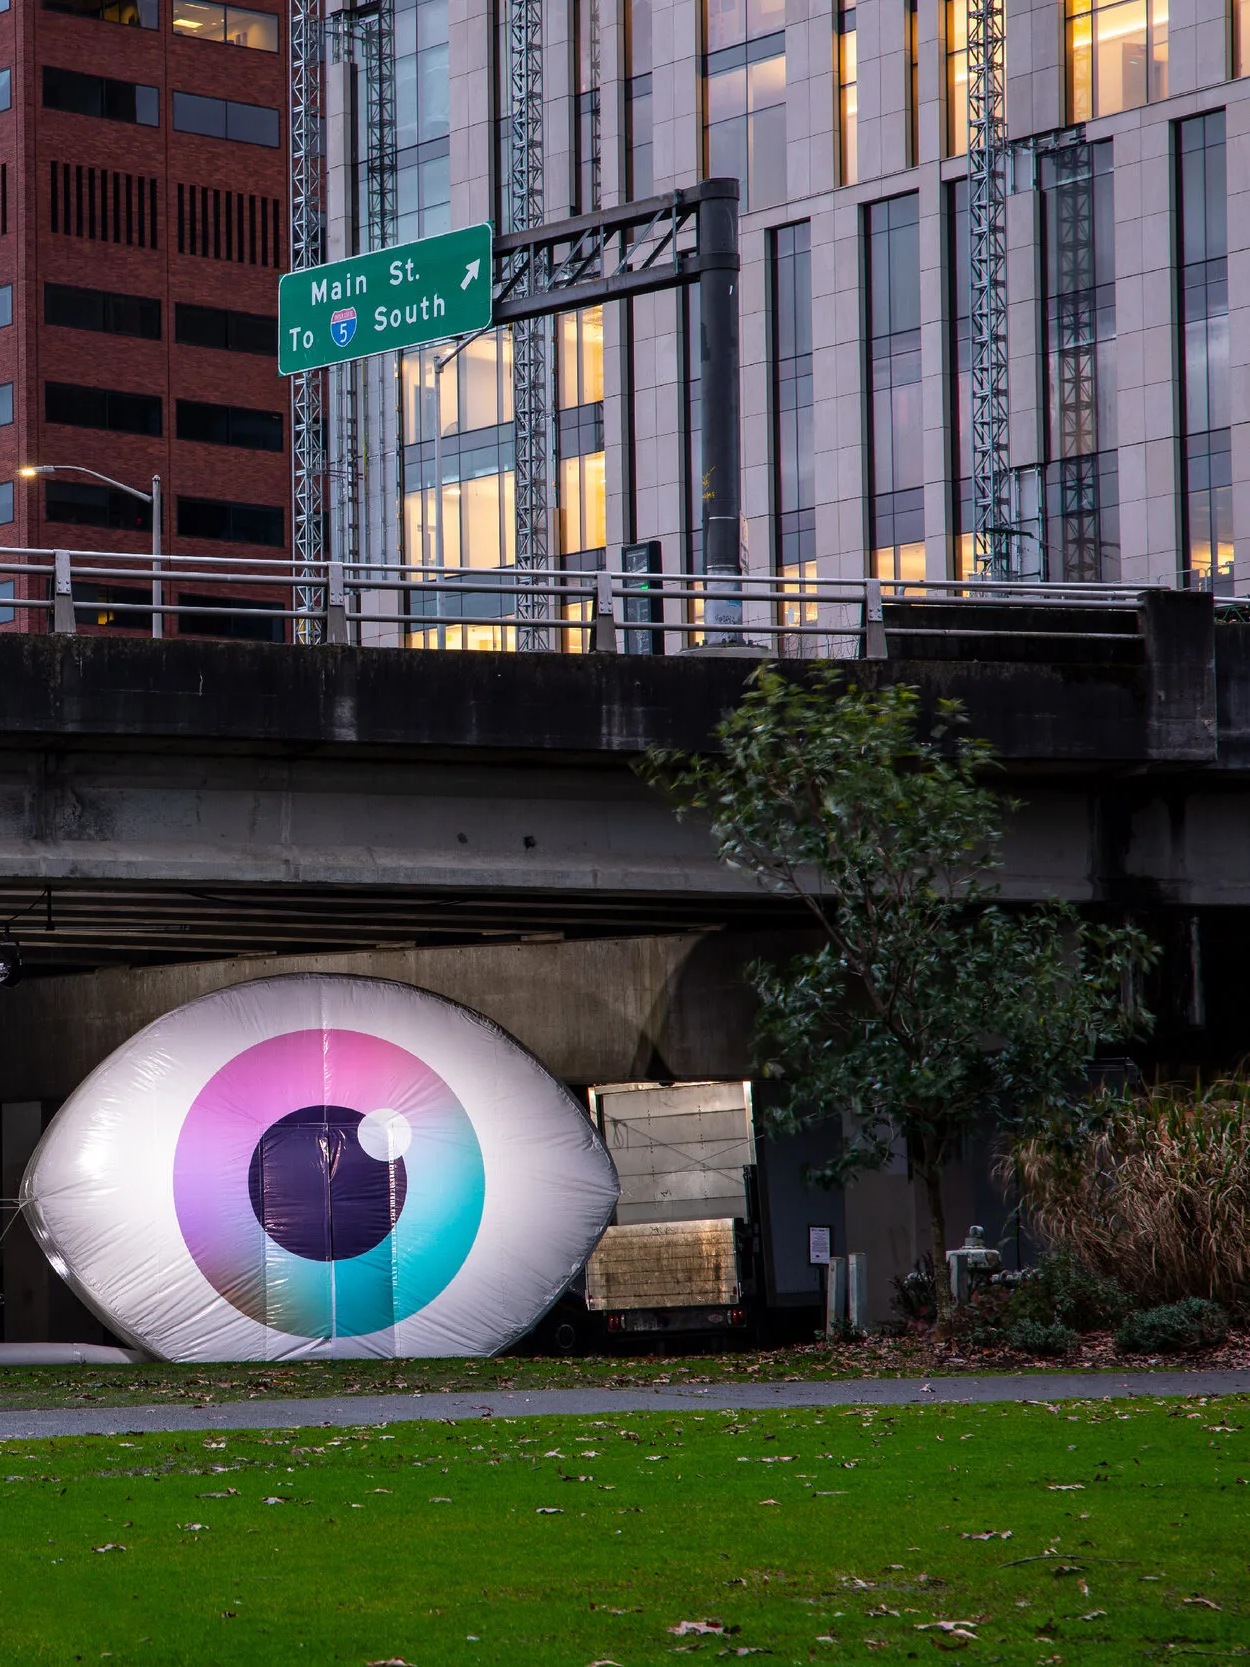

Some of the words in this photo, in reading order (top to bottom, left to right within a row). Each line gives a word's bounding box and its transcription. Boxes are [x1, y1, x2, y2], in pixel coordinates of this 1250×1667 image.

[311, 273, 367, 306] Main
[389, 257, 420, 286] St.
[289, 326, 314, 352] To
[339, 323, 348, 343] 5
[373, 293, 445, 332] South
